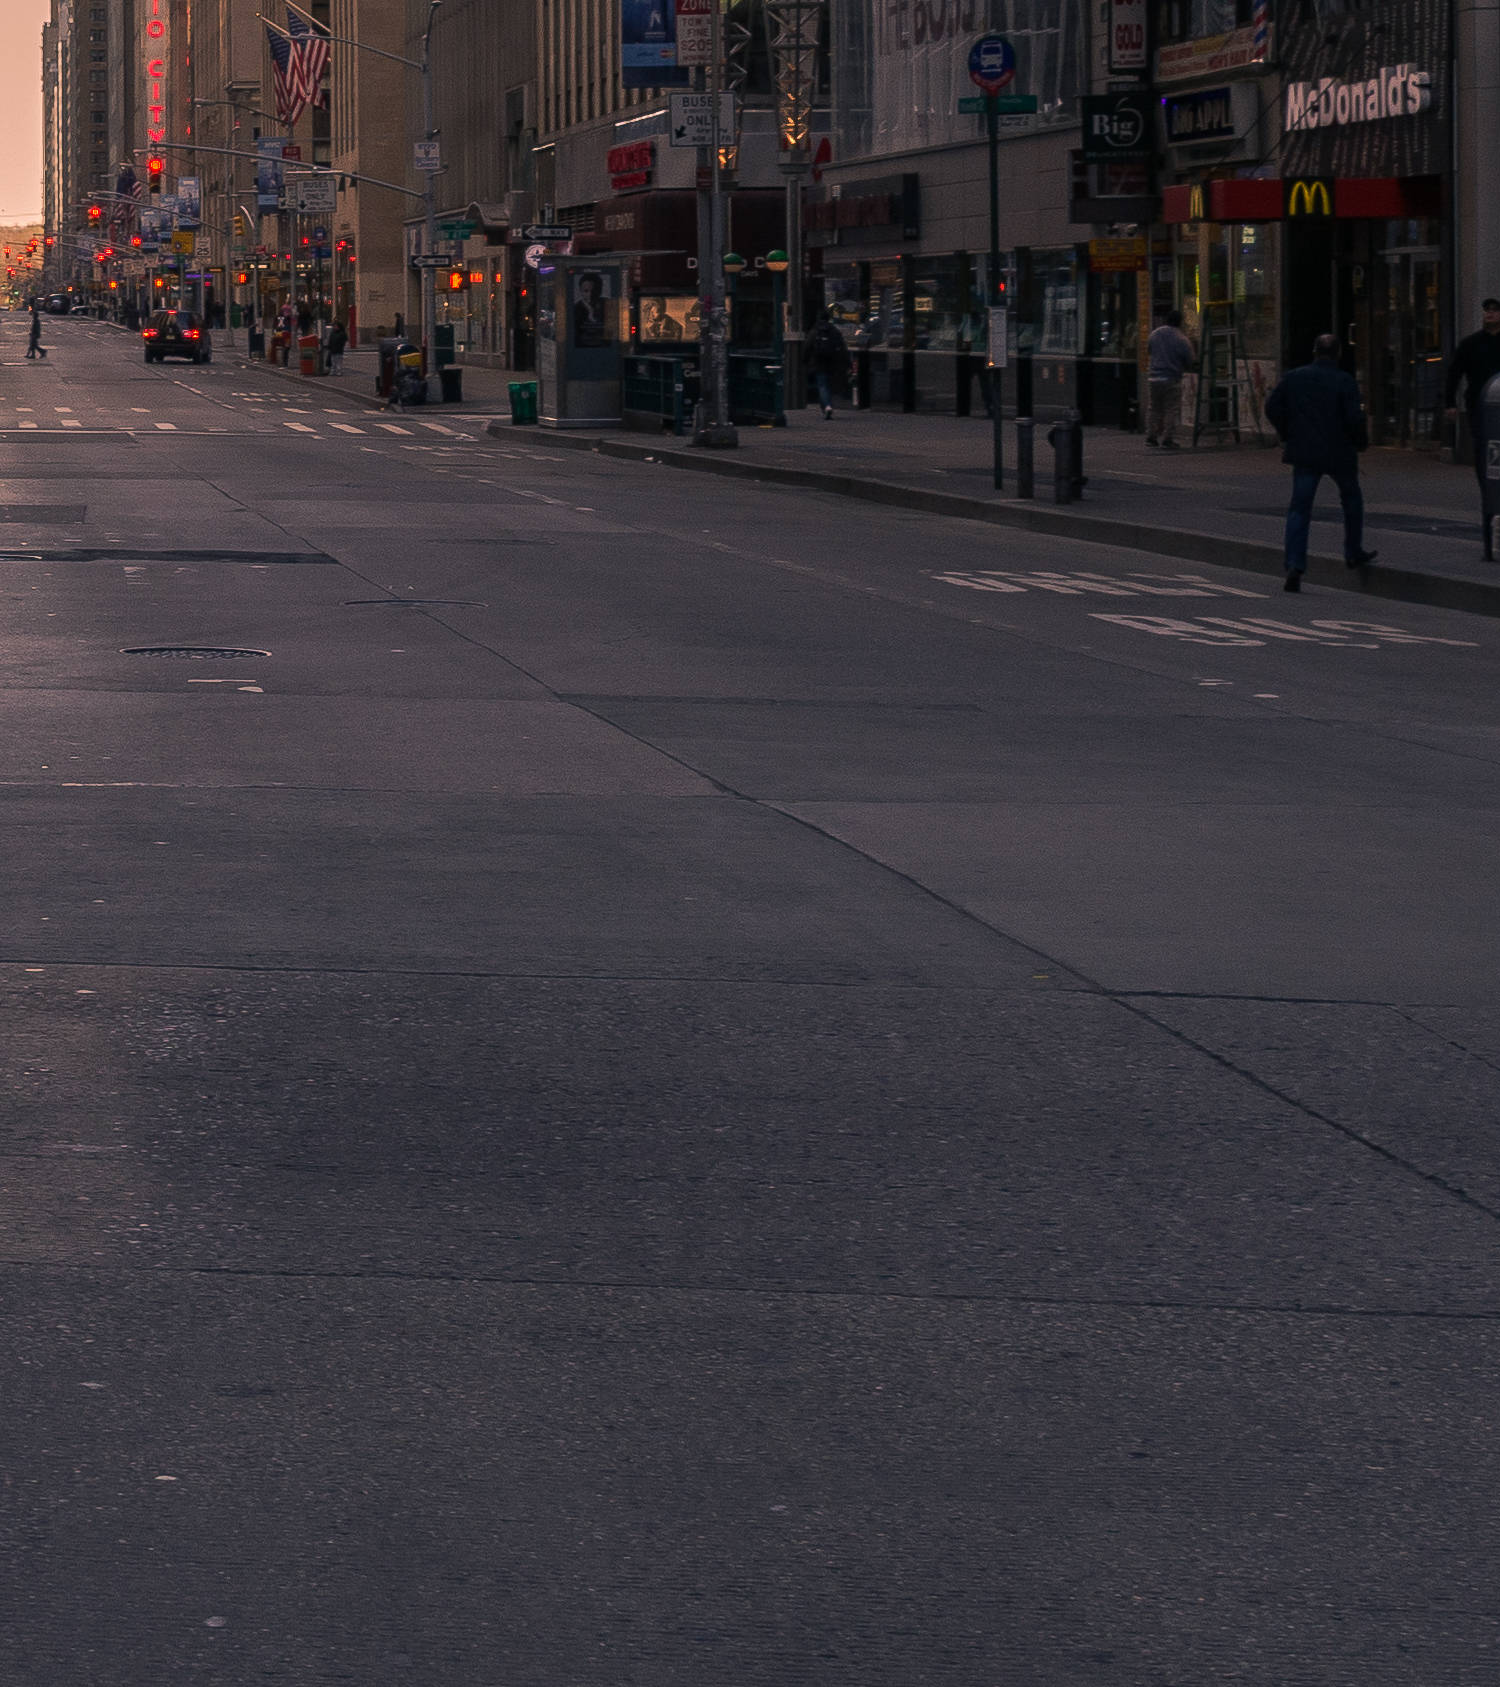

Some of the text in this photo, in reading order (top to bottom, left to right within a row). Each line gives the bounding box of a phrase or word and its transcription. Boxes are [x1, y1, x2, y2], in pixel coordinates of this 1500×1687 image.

[1116, 24, 1143, 50] GOLD
[148, 60, 164, 142] CITY
[1285, 63, 1428, 132] McDonald's
[1093, 114, 1136, 136] Big
[197, 248, 209, 256] 25
[1087, 612, 1480, 650] BUS
